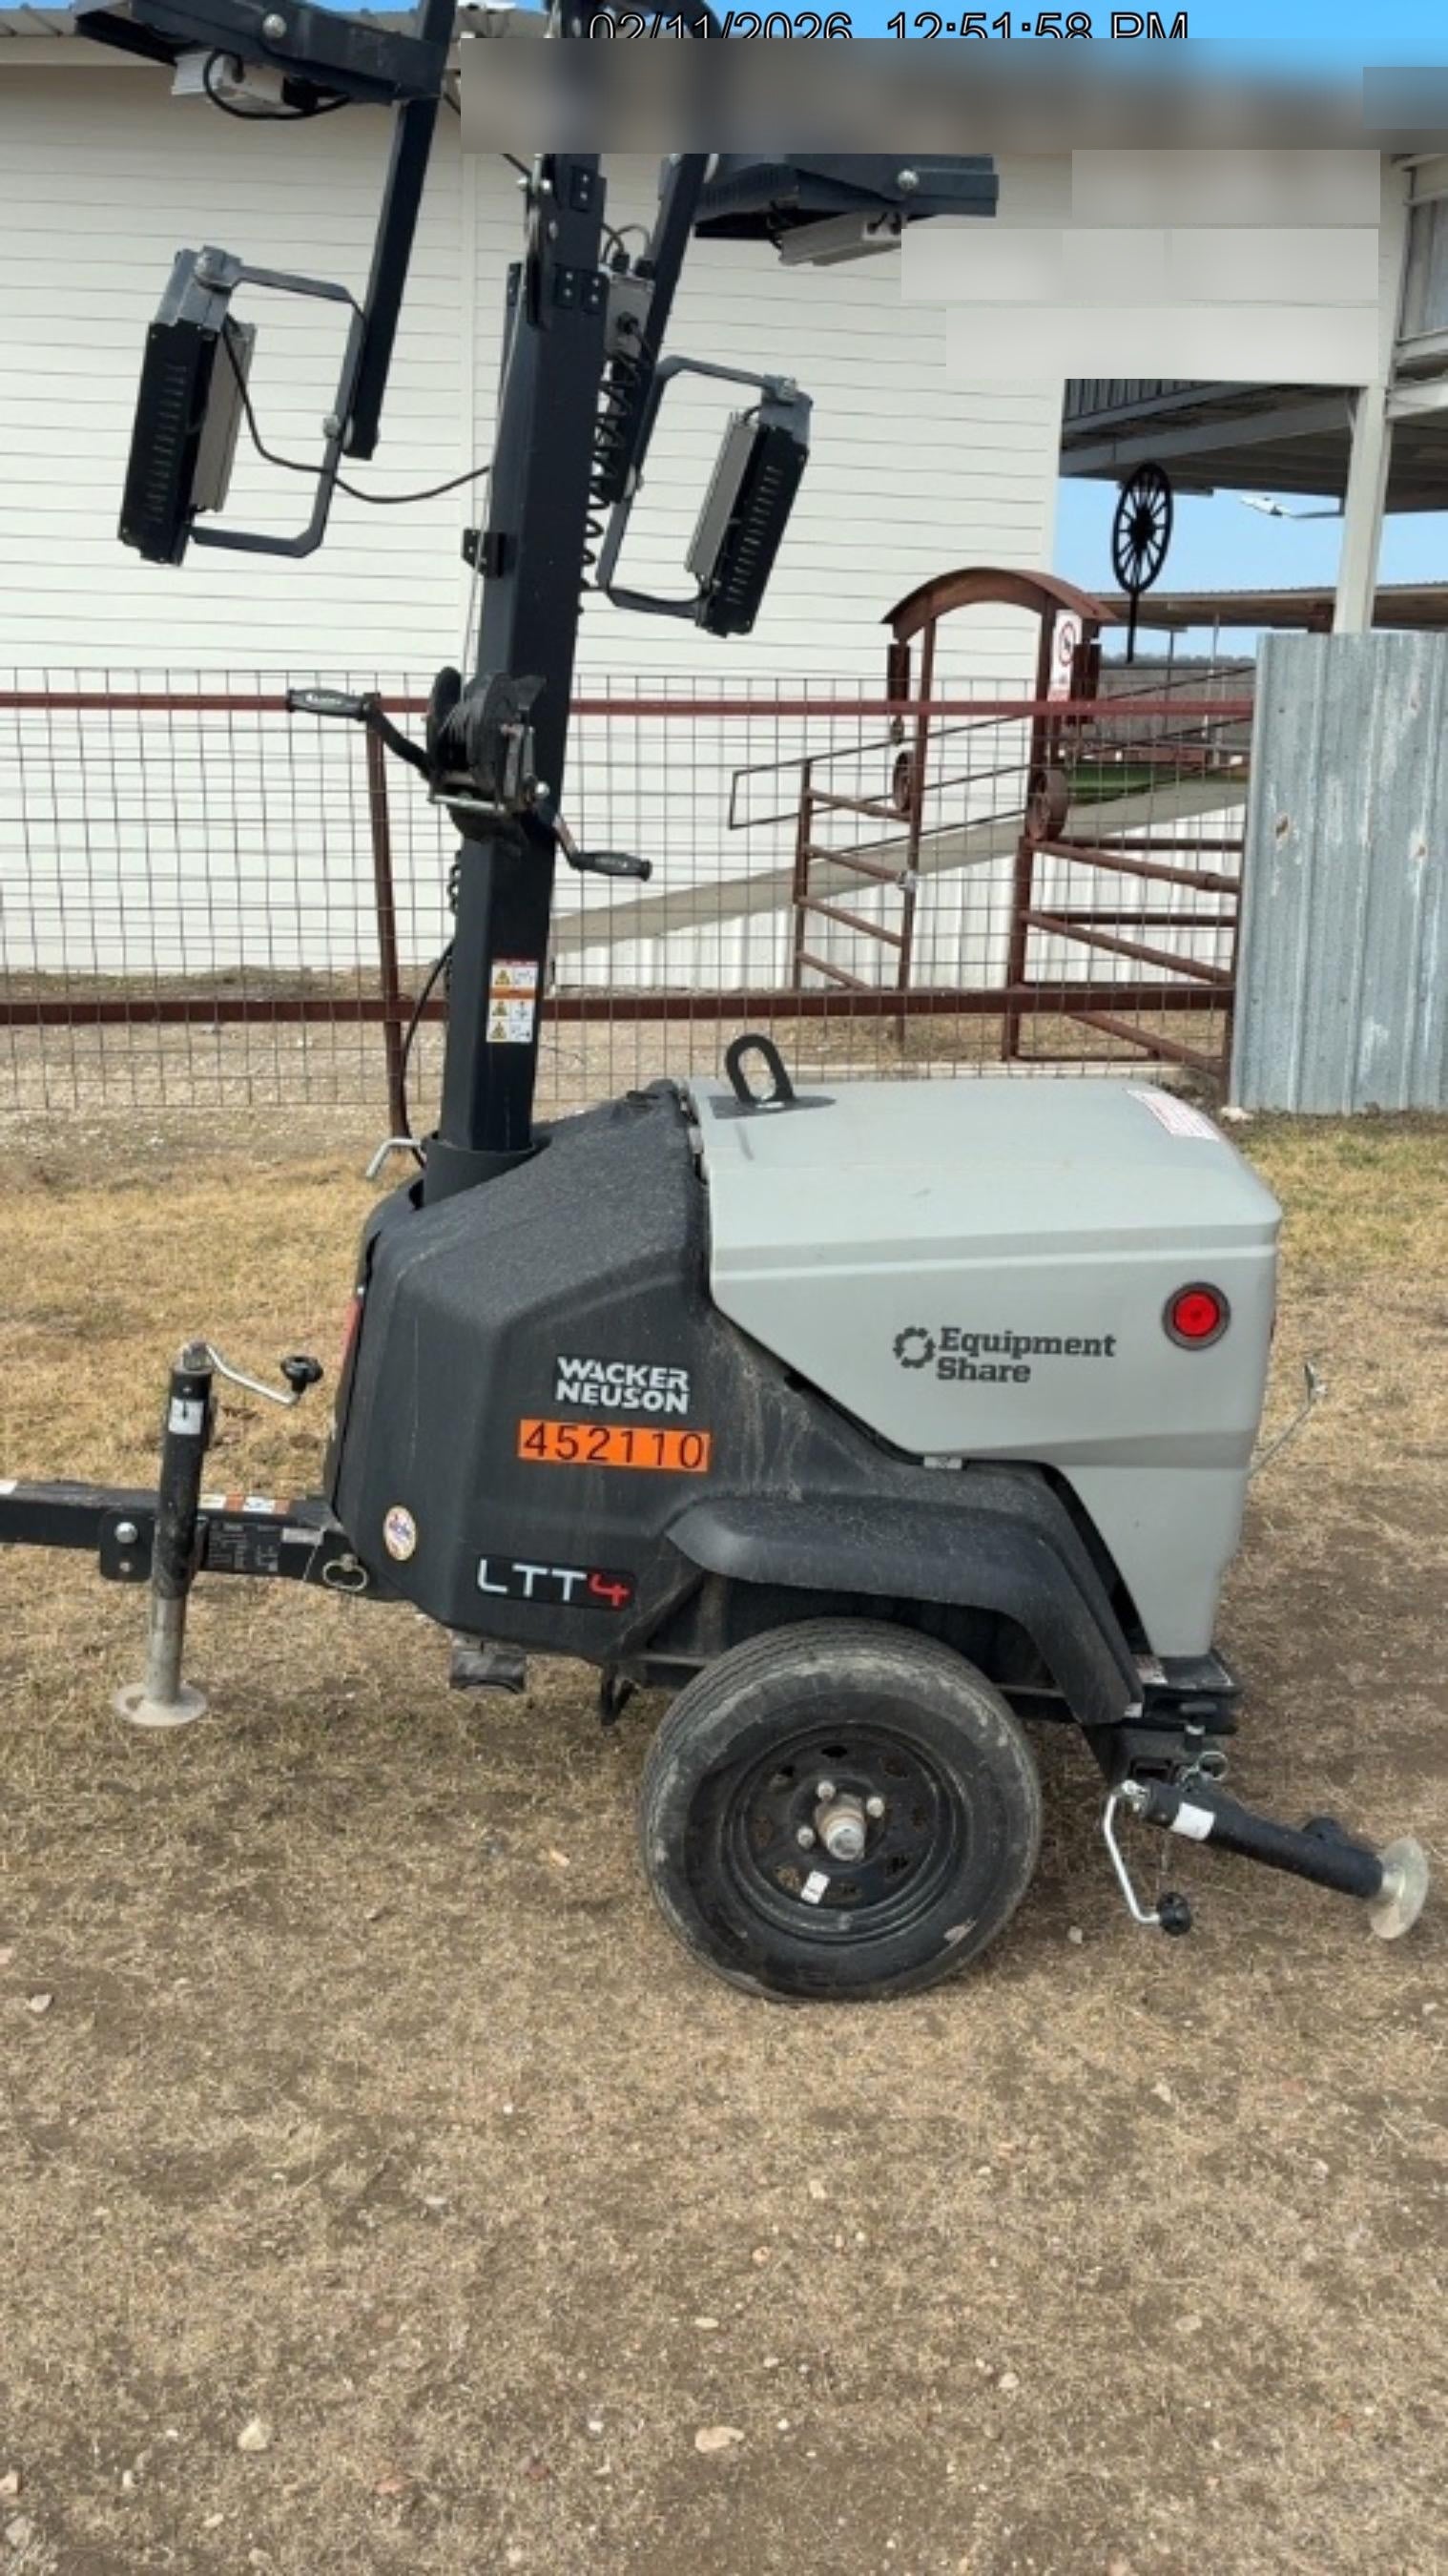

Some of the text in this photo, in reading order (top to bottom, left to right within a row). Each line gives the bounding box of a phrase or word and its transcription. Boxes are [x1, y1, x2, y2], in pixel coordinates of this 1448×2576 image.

[938, 1325, 1117, 1360] Equipment
[557, 1356, 690, 1391] WACKER
[937, 1356, 1032, 1383] Share
[555, 1379, 690, 1415] NEUSON
[524, 1422, 704, 1469] 452110
[477, 1558, 631, 1608] LTT4
